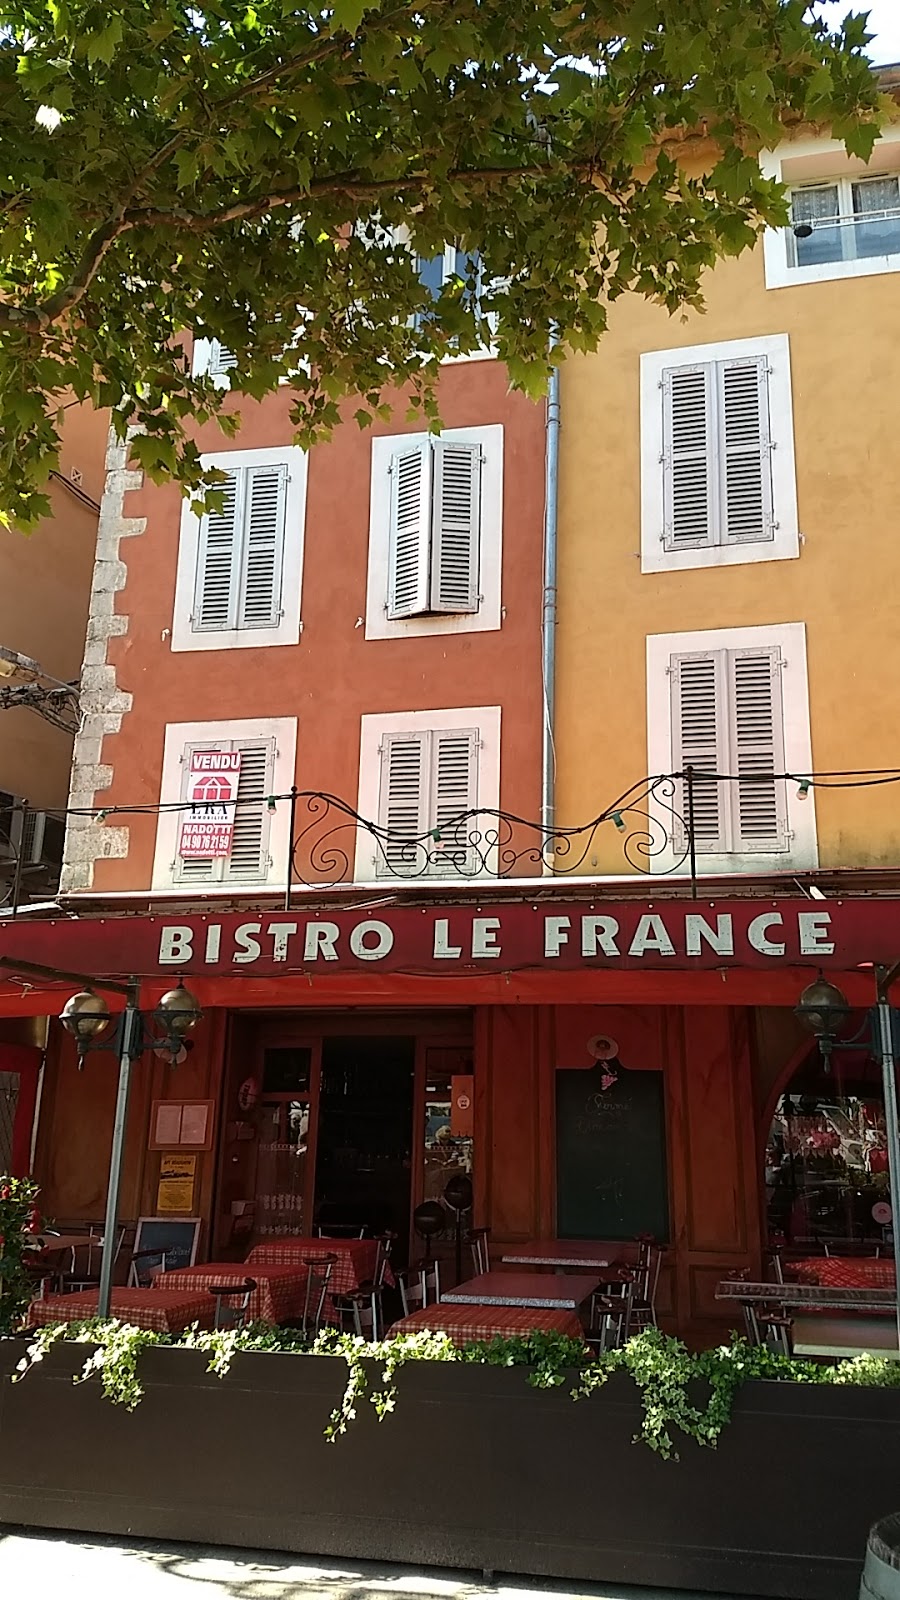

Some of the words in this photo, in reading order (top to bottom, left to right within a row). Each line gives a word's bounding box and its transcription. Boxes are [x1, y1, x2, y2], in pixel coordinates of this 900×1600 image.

[193, 753, 240, 770] VENDU
[183, 824, 231, 835] NADOTTI
[158, 920, 394, 964] BISTRO
[433, 918, 501, 959] LE
[544, 912, 835, 957] FRANCE
